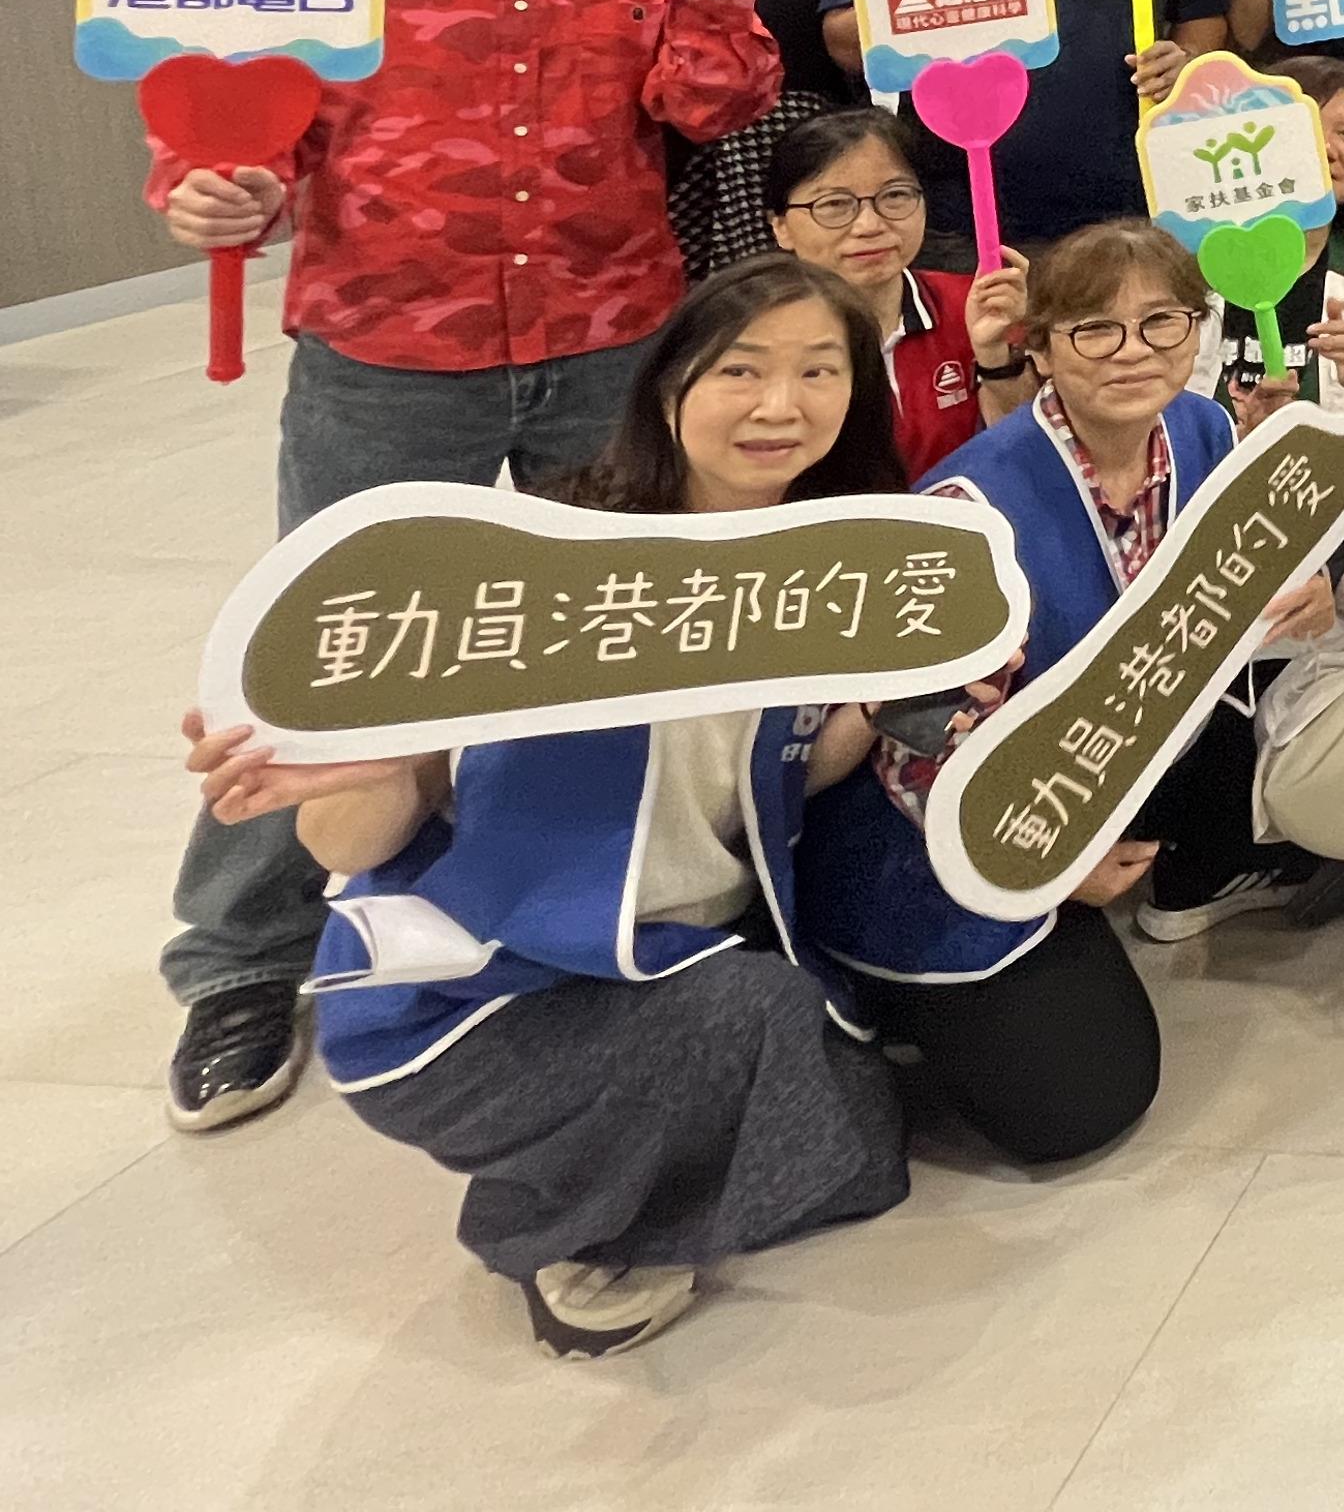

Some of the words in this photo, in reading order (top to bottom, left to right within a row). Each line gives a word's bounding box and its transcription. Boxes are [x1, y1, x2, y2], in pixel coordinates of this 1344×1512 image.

[1184, 177, 1296, 213] 家扶基金會
[311, 551, 957, 688] 動員港都的愛
[994, 452, 1338, 859] 動員港都的愛
